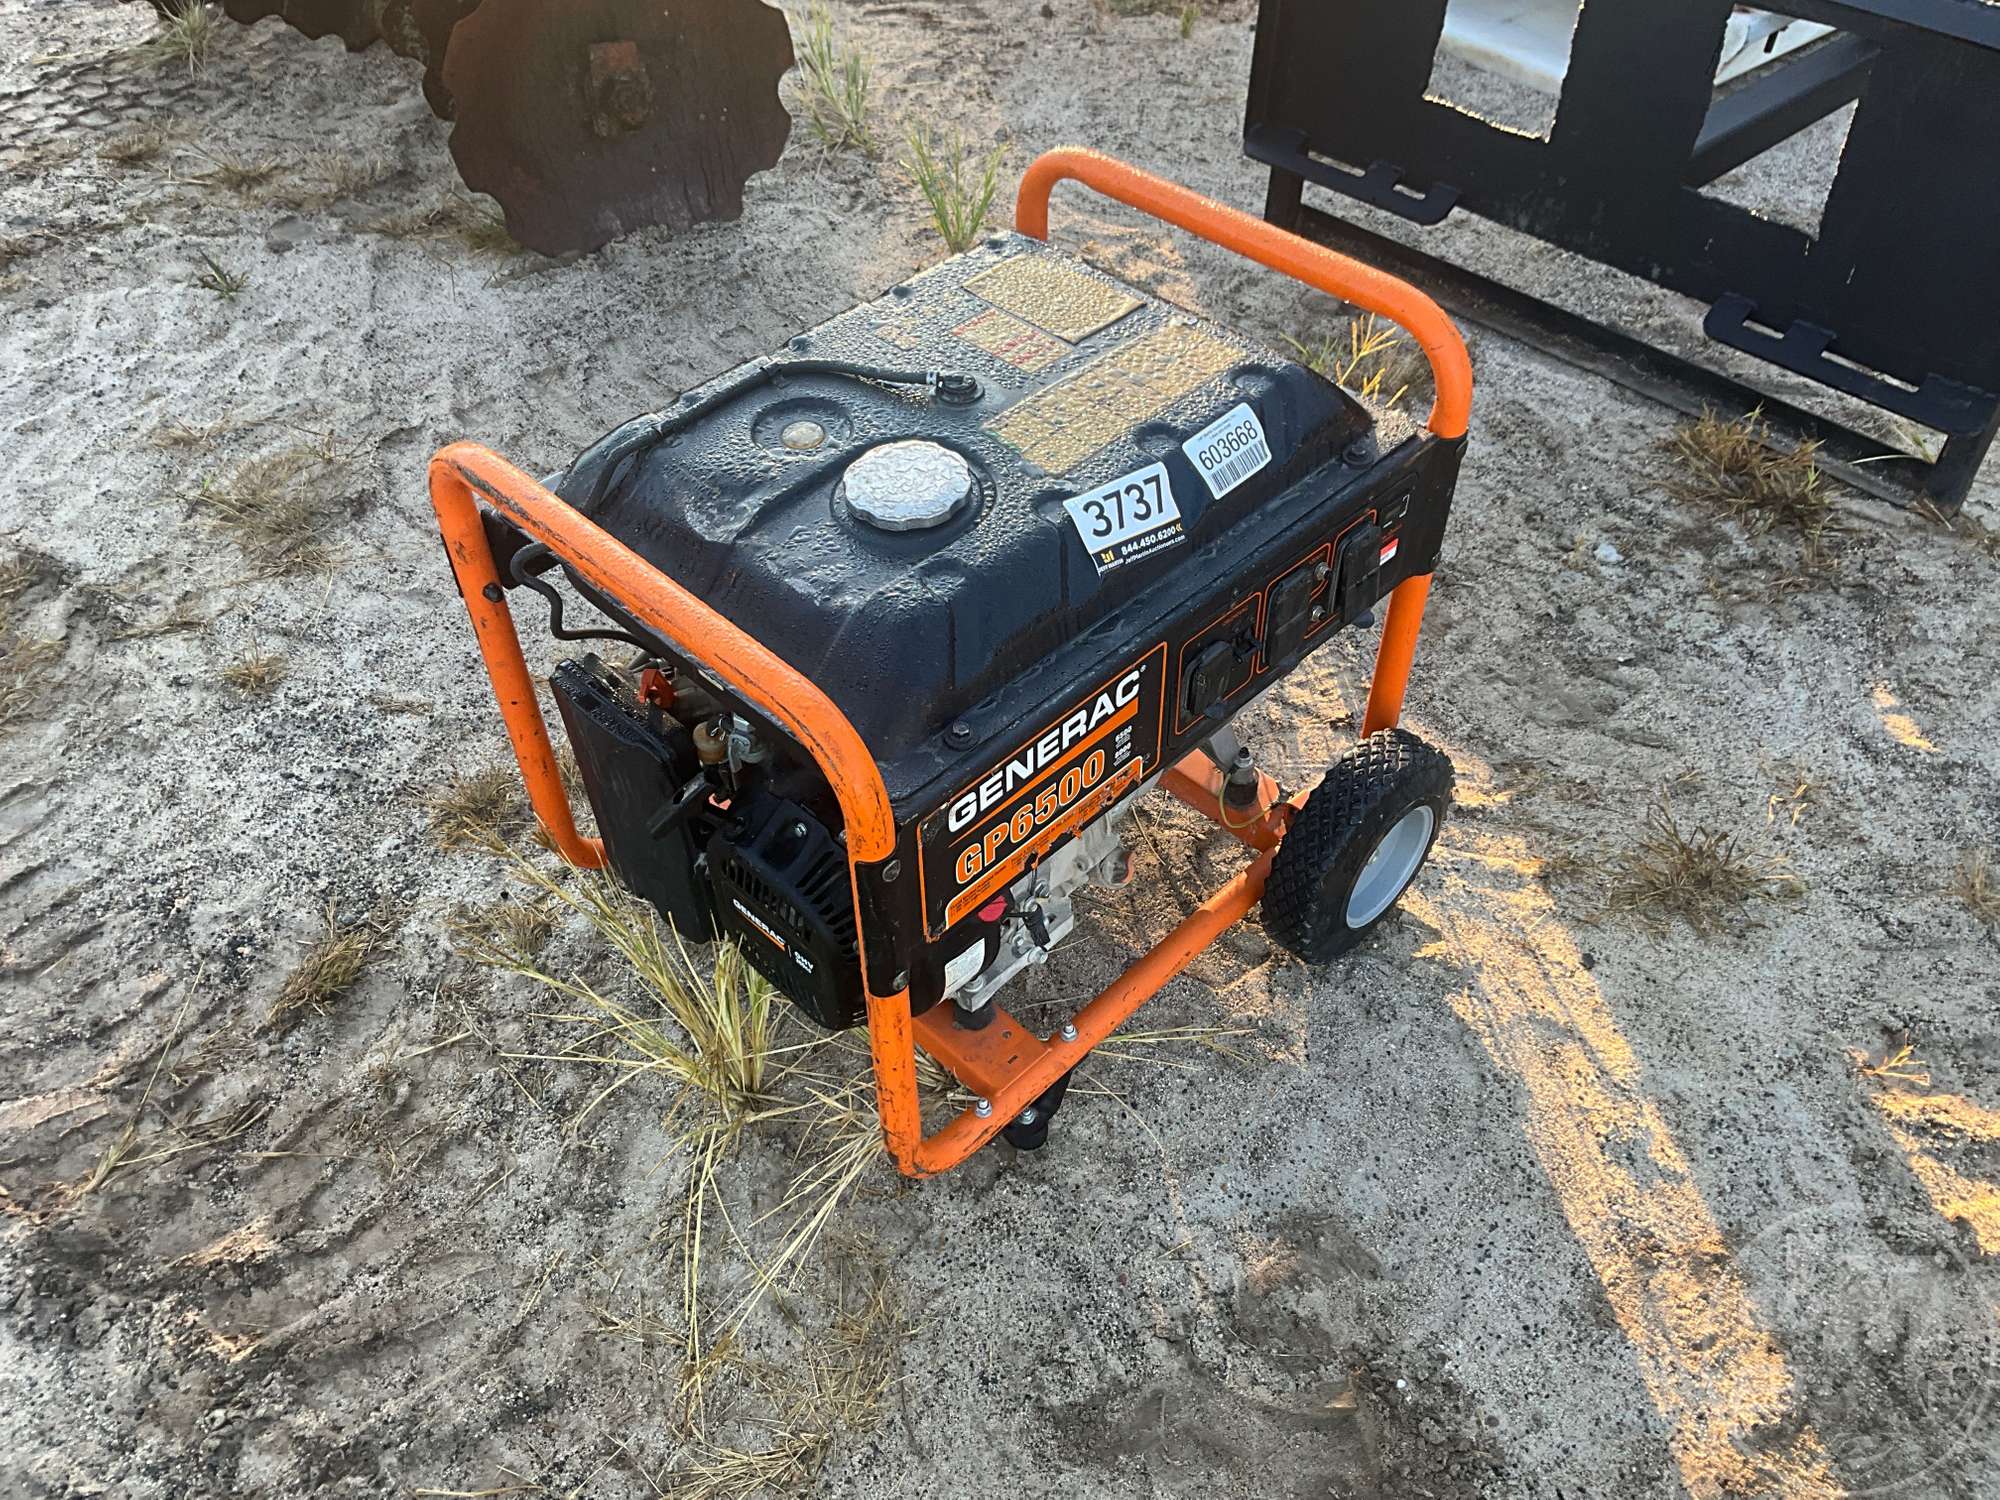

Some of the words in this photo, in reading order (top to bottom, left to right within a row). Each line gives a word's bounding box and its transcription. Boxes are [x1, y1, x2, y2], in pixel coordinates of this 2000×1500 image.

[1198, 420, 1258, 471] 603668
[1082, 474, 1164, 538] 3737
[1120, 527, 1176, 556] 844.450.6200
[948, 670, 1140, 833] GENERAC
[955, 749, 1106, 885] GP6500
[733, 899, 786, 946] GENERAC
